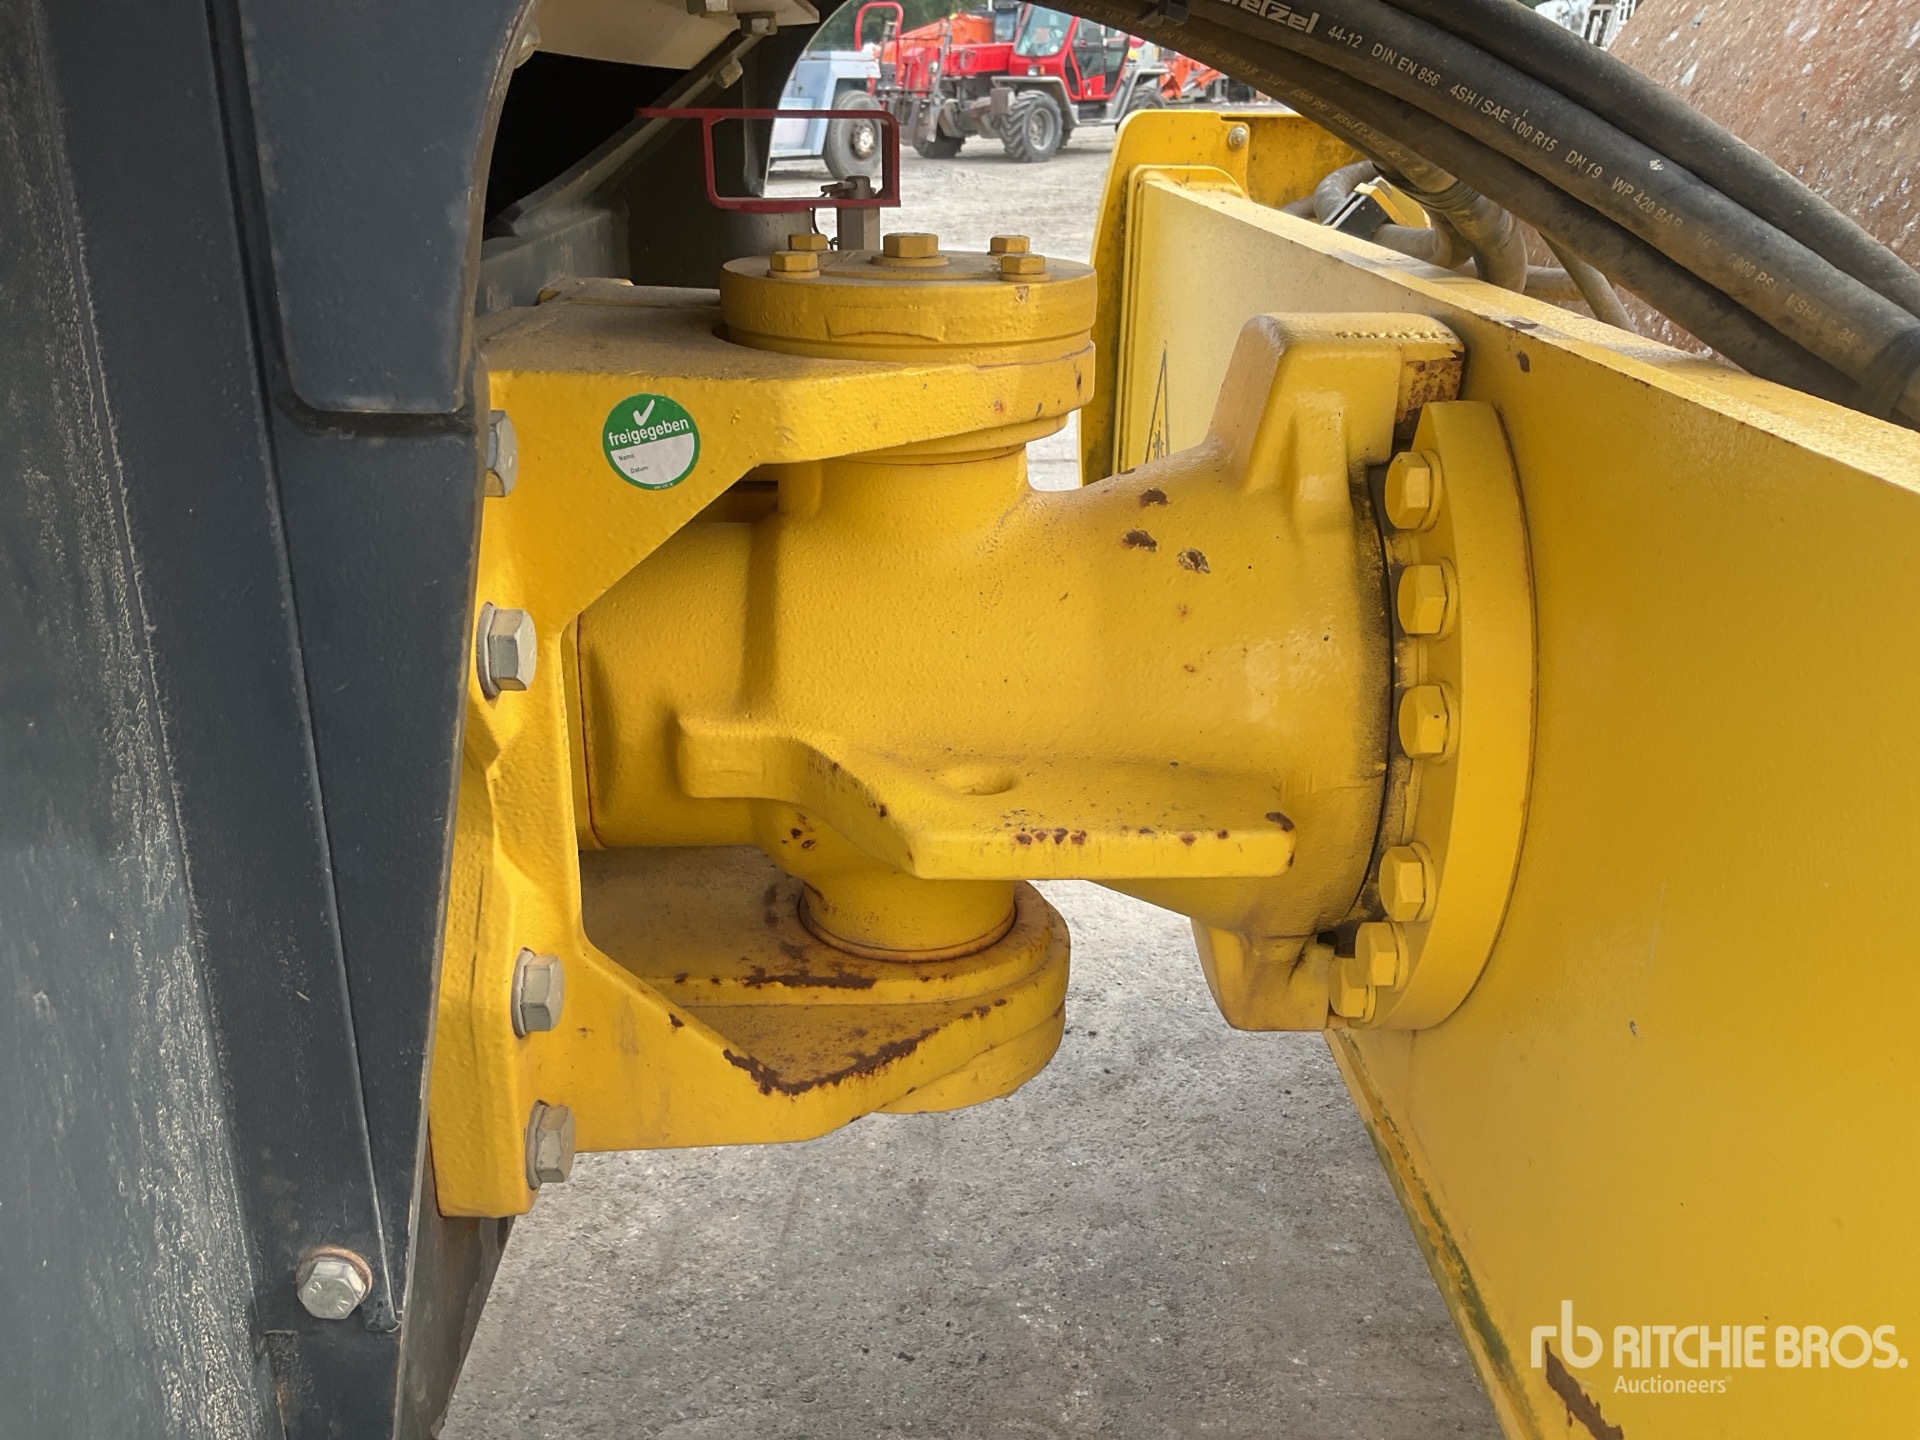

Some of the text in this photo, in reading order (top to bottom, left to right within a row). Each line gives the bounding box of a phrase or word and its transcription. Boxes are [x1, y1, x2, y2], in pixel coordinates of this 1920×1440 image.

[1221, 0, 1320, 34] etzel
[1328, 25, 1363, 48] 44-12
[1371, 43, 1397, 65] DIN
[1397, 58, 1418, 80] EN
[1417, 67, 1440, 87] 856
[1449, 84, 1477, 108] 4SH
[1481, 101, 1511, 124] SAE
[1512, 115, 1532, 138] 100
[1532, 131, 1558, 152] R15
[1565, 150, 1589, 170] DN
[1585, 161, 1603, 179] 19
[1611, 176, 1635, 198] WP
[1633, 189, 1656, 213] 420
[1654, 207, 1684, 229] BAR
[608, 418, 690, 447] freigegeben
